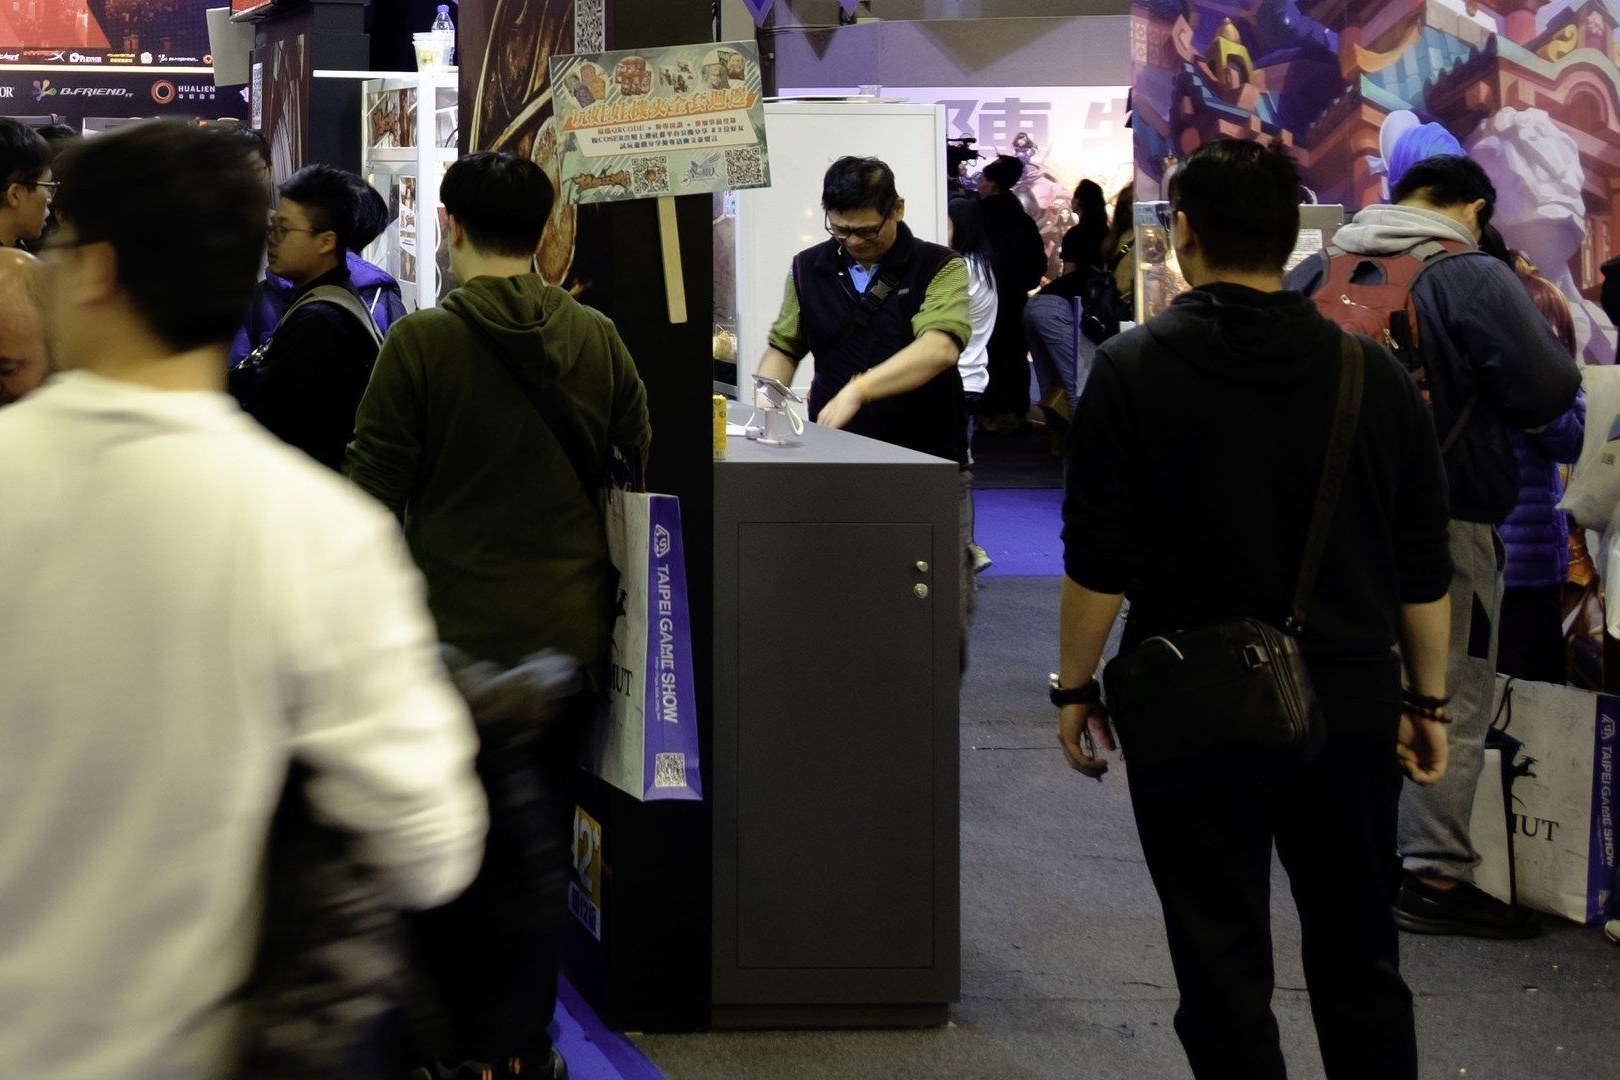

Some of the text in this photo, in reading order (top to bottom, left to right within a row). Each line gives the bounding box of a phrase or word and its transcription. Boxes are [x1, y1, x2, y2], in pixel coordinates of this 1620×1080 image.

[178, 85, 216, 93] HUALIEN
[656, 564, 679, 724] TAIPEI GAME SHOW
[1601, 745, 1613, 784] TAIPEI
[1603, 828, 1615, 868] SHOW
